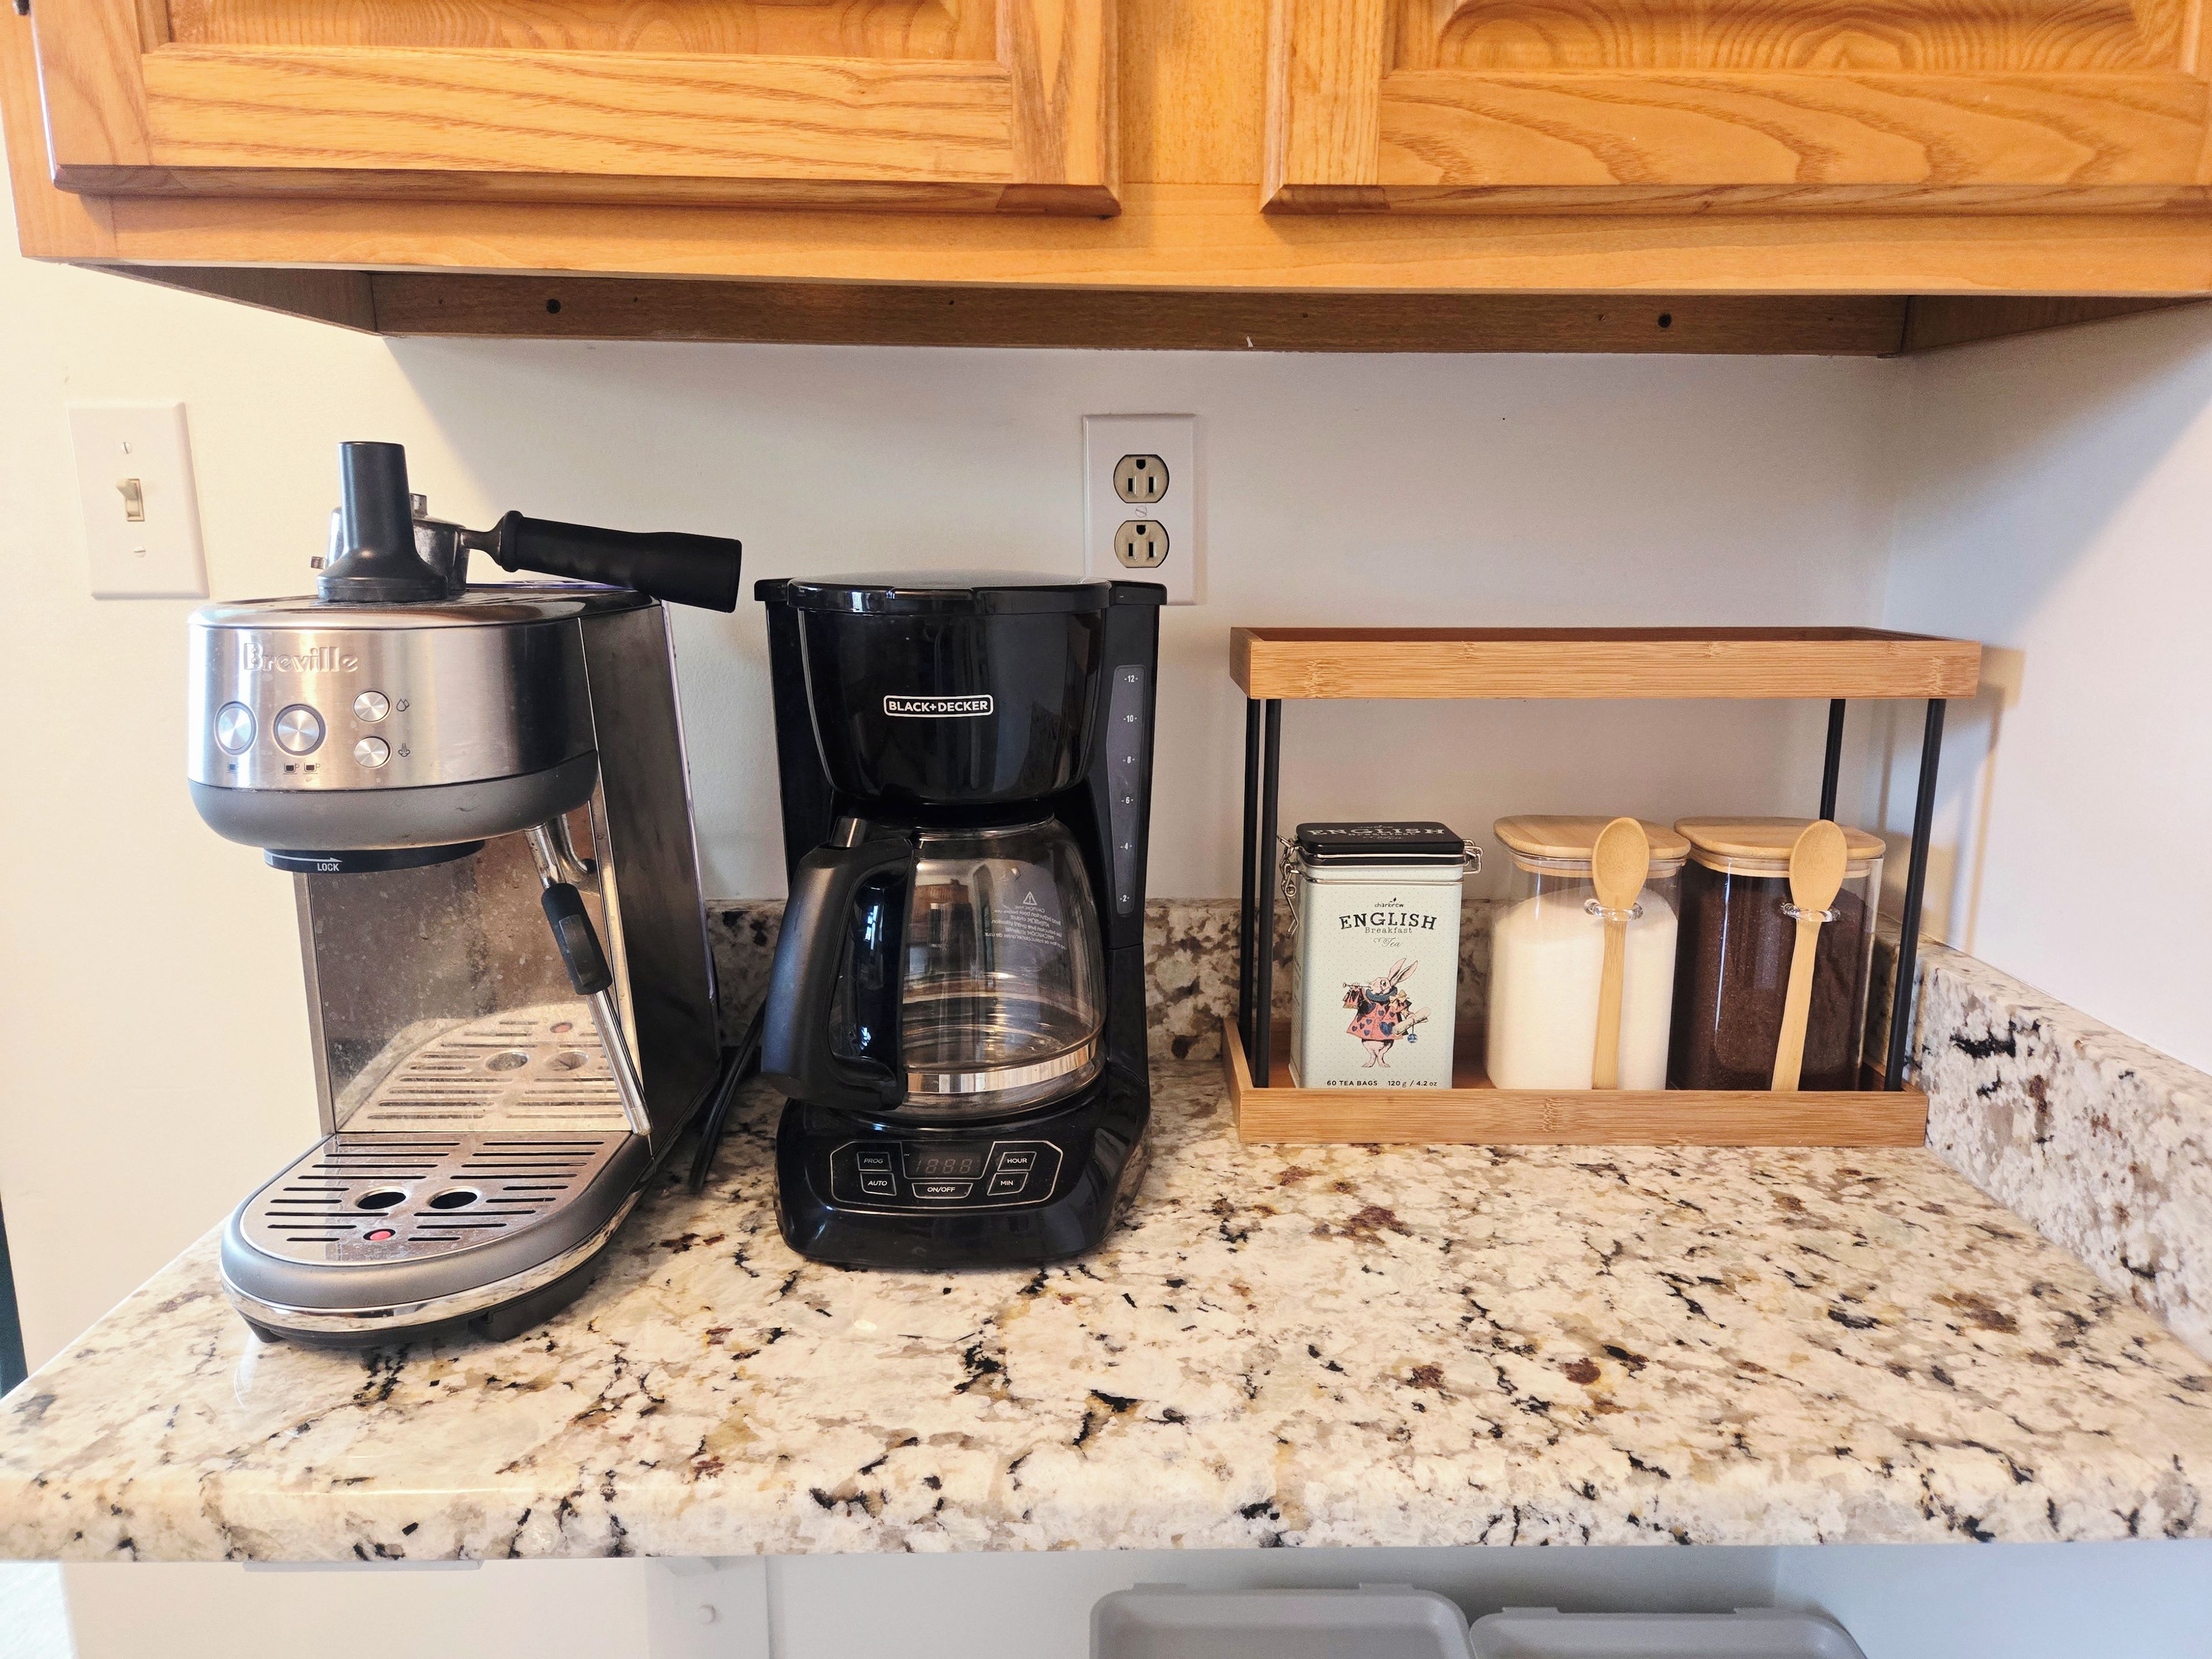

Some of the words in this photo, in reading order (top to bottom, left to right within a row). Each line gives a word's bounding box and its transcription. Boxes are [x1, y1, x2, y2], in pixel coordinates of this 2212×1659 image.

[244, 642, 358, 672] Breville
[889, 700, 988, 712] BLACK+DECKER
[317, 863, 339, 871] LOCK
[1339, 912, 1437, 930] ENGLISH
[1373, 937, 1402, 948] Tea
